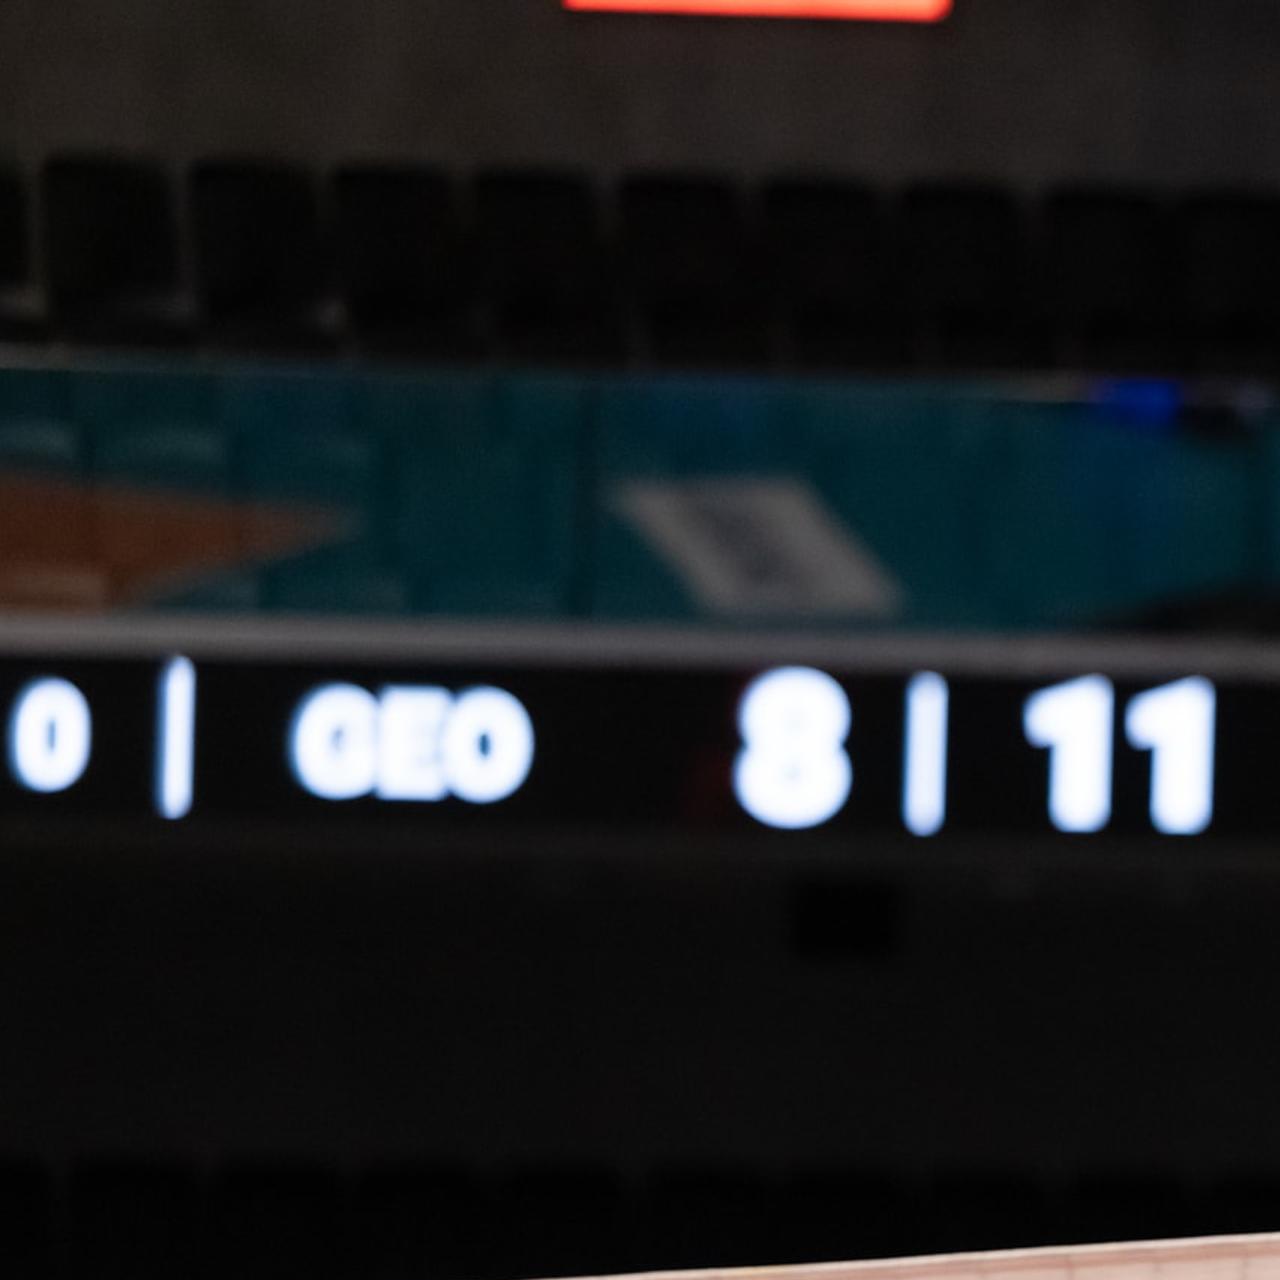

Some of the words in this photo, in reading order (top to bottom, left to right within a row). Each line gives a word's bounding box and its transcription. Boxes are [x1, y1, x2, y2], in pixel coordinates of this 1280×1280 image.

[11, 678, 91, 792] 0
[291, 684, 535, 803] GEO
[735, 667, 851, 828] 8
[1024, 675, 1215, 834] 11
